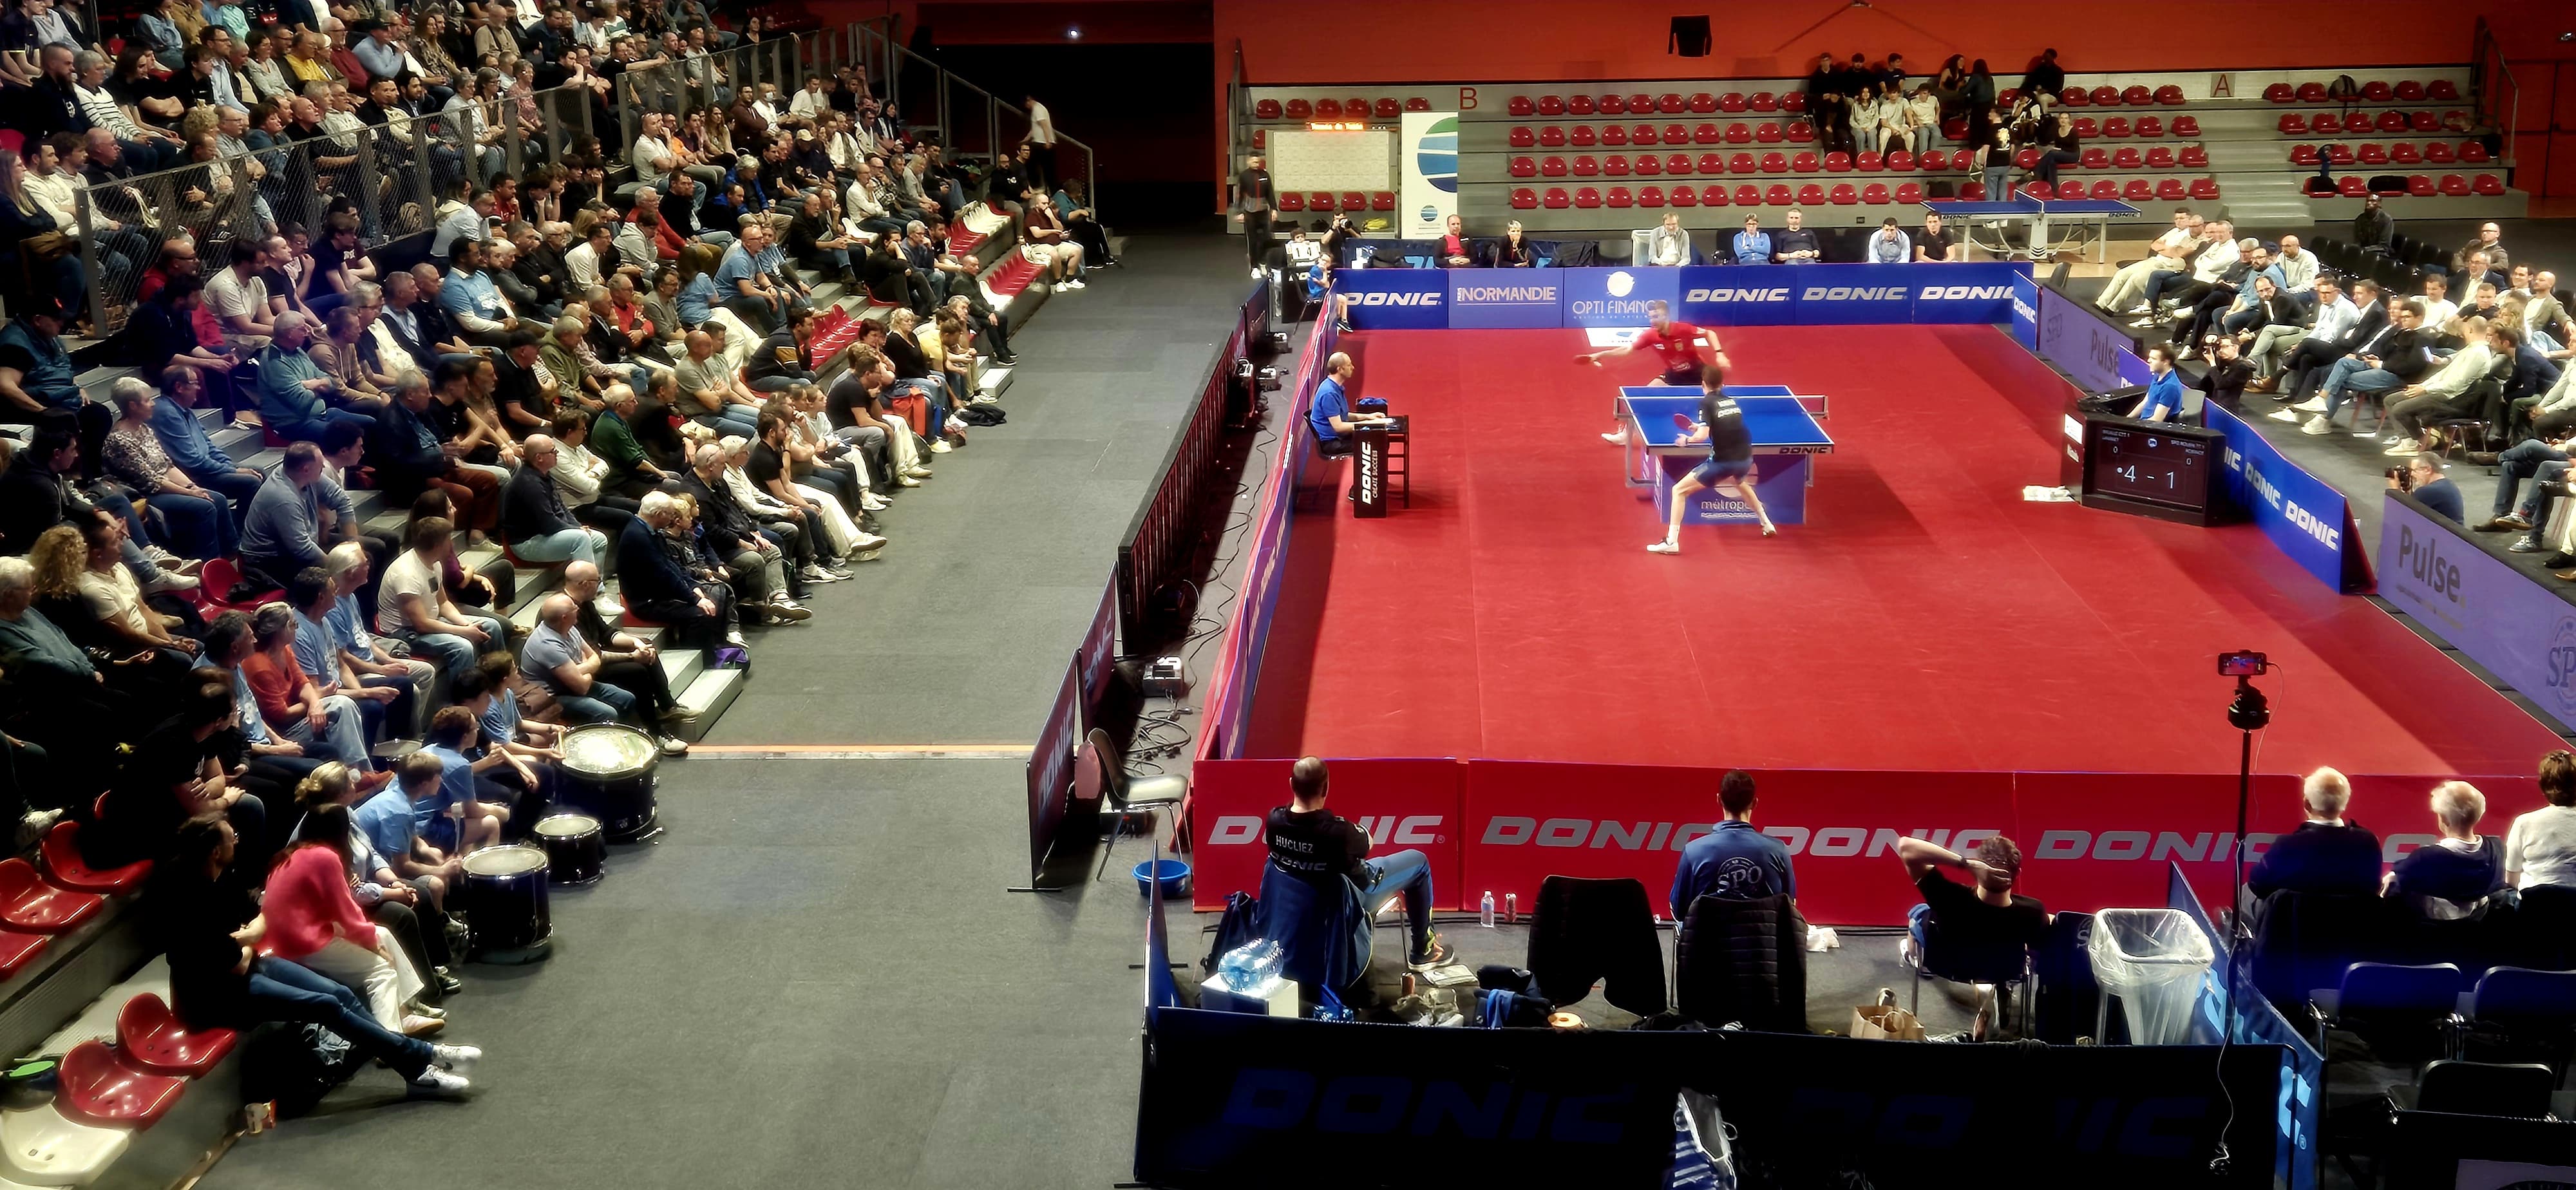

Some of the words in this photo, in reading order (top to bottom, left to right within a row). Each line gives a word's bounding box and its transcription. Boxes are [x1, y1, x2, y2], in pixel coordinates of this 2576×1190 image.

[2213, 73, 2231, 97] A
[1459, 87, 1478, 109] B
[1345, 292, 1441, 306] DONIC
[1461, 287, 1557, 301] NORMANDIE
[1685, 288, 1790, 301] DONIC
[1802, 287, 1908, 300] DONIC
[1572, 301, 1604, 314] OPTI
[2013, 297, 2036, 324] DONIC
[1361, 441, 1372, 505] DONIC
[2124, 465, 2136, 482] 4
[2166, 471, 2175, 489] 1
[2245, 462, 2281, 511] DONIC
[2286, 500, 2340, 552] DONIC
[1716, 865, 1763, 894] SPO
